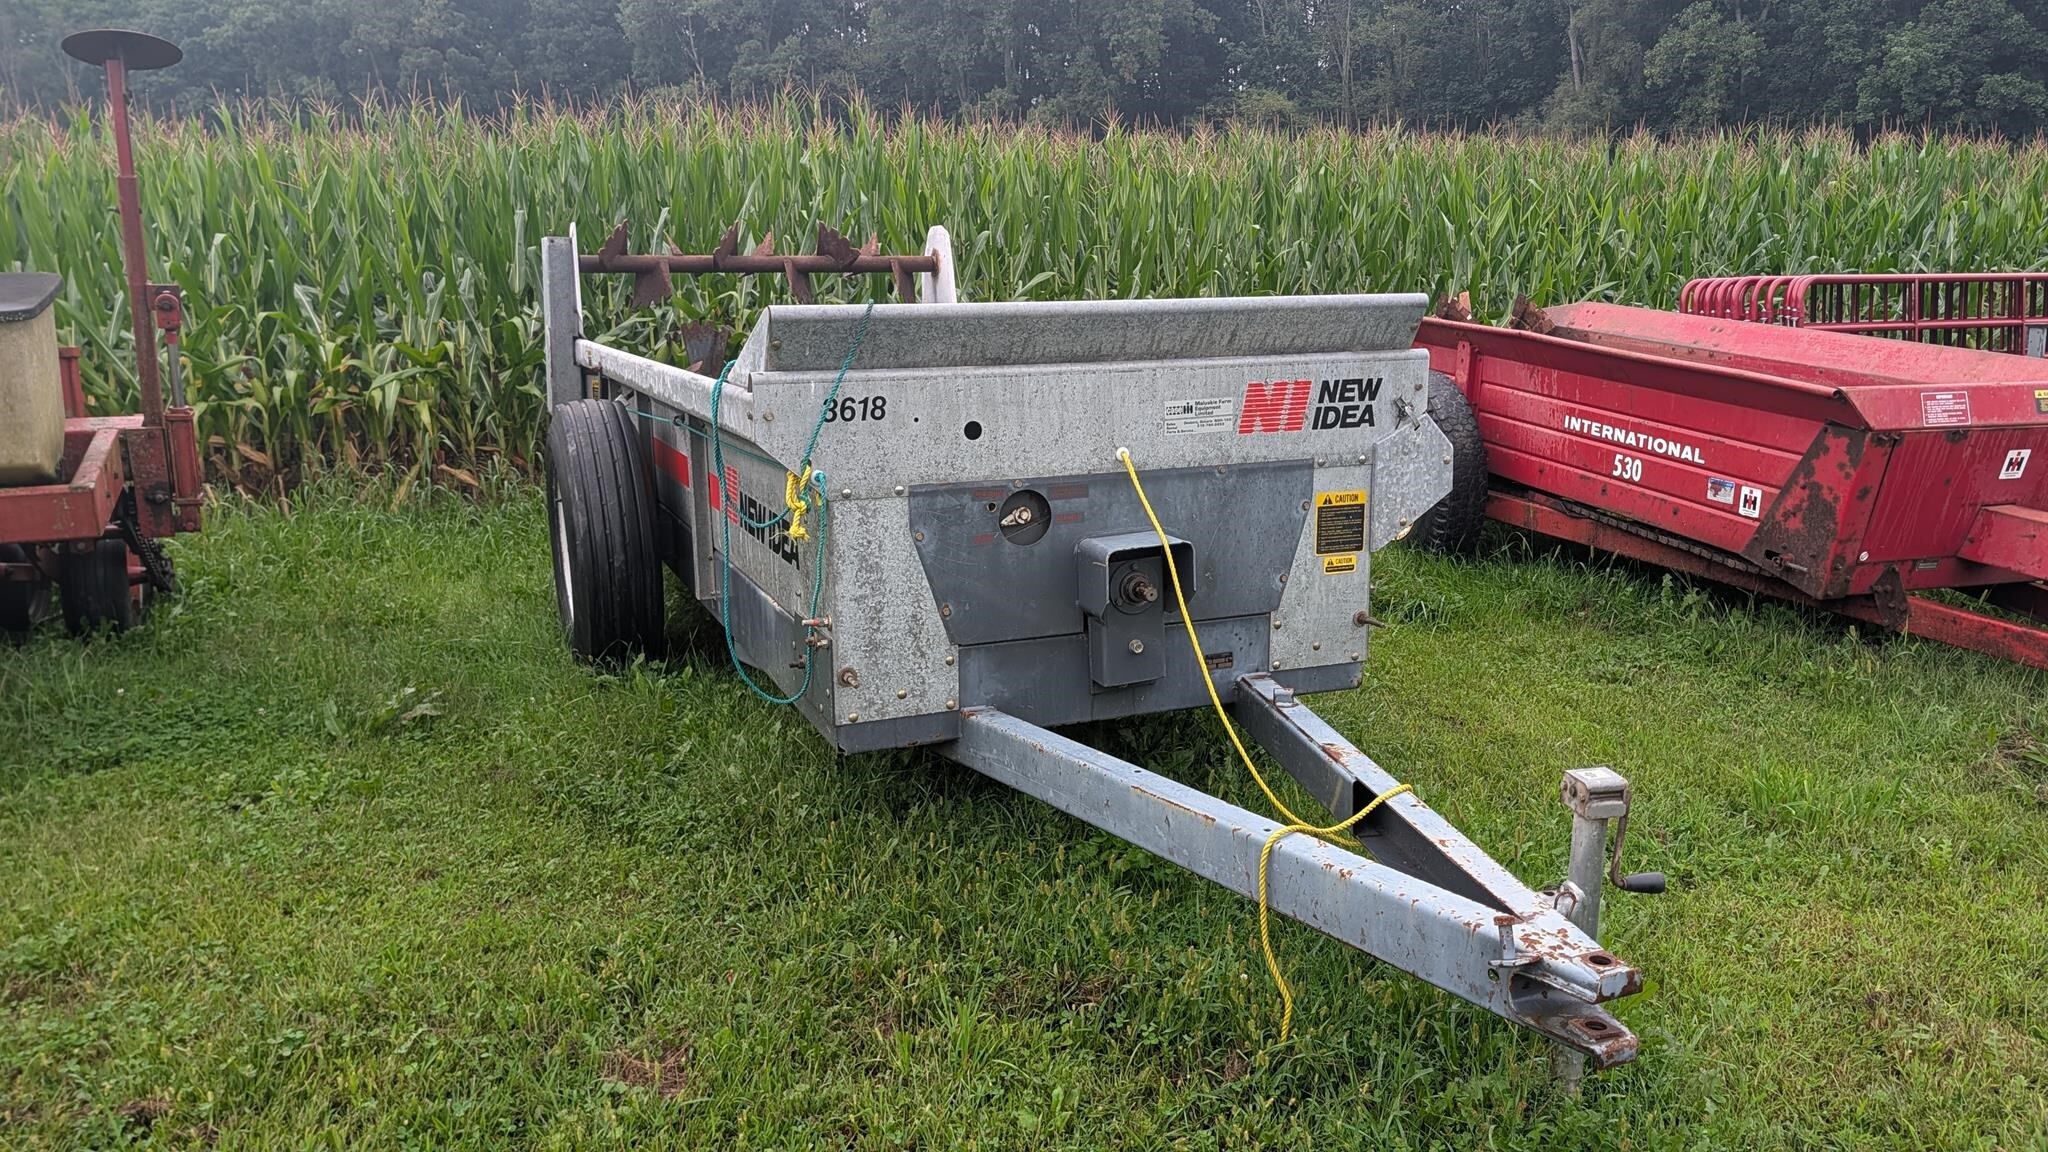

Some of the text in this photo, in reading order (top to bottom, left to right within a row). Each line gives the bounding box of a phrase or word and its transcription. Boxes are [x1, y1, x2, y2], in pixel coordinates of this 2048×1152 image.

[1318, 378, 1383, 403] NEW
[823, 396, 887, 423] 3618
[1312, 404, 1375, 430] IDEA
[1564, 415, 1705, 464] INTERNATIONAL
[1612, 454, 1642, 482] 530
[1335, 493, 1359, 503] CAUTION
